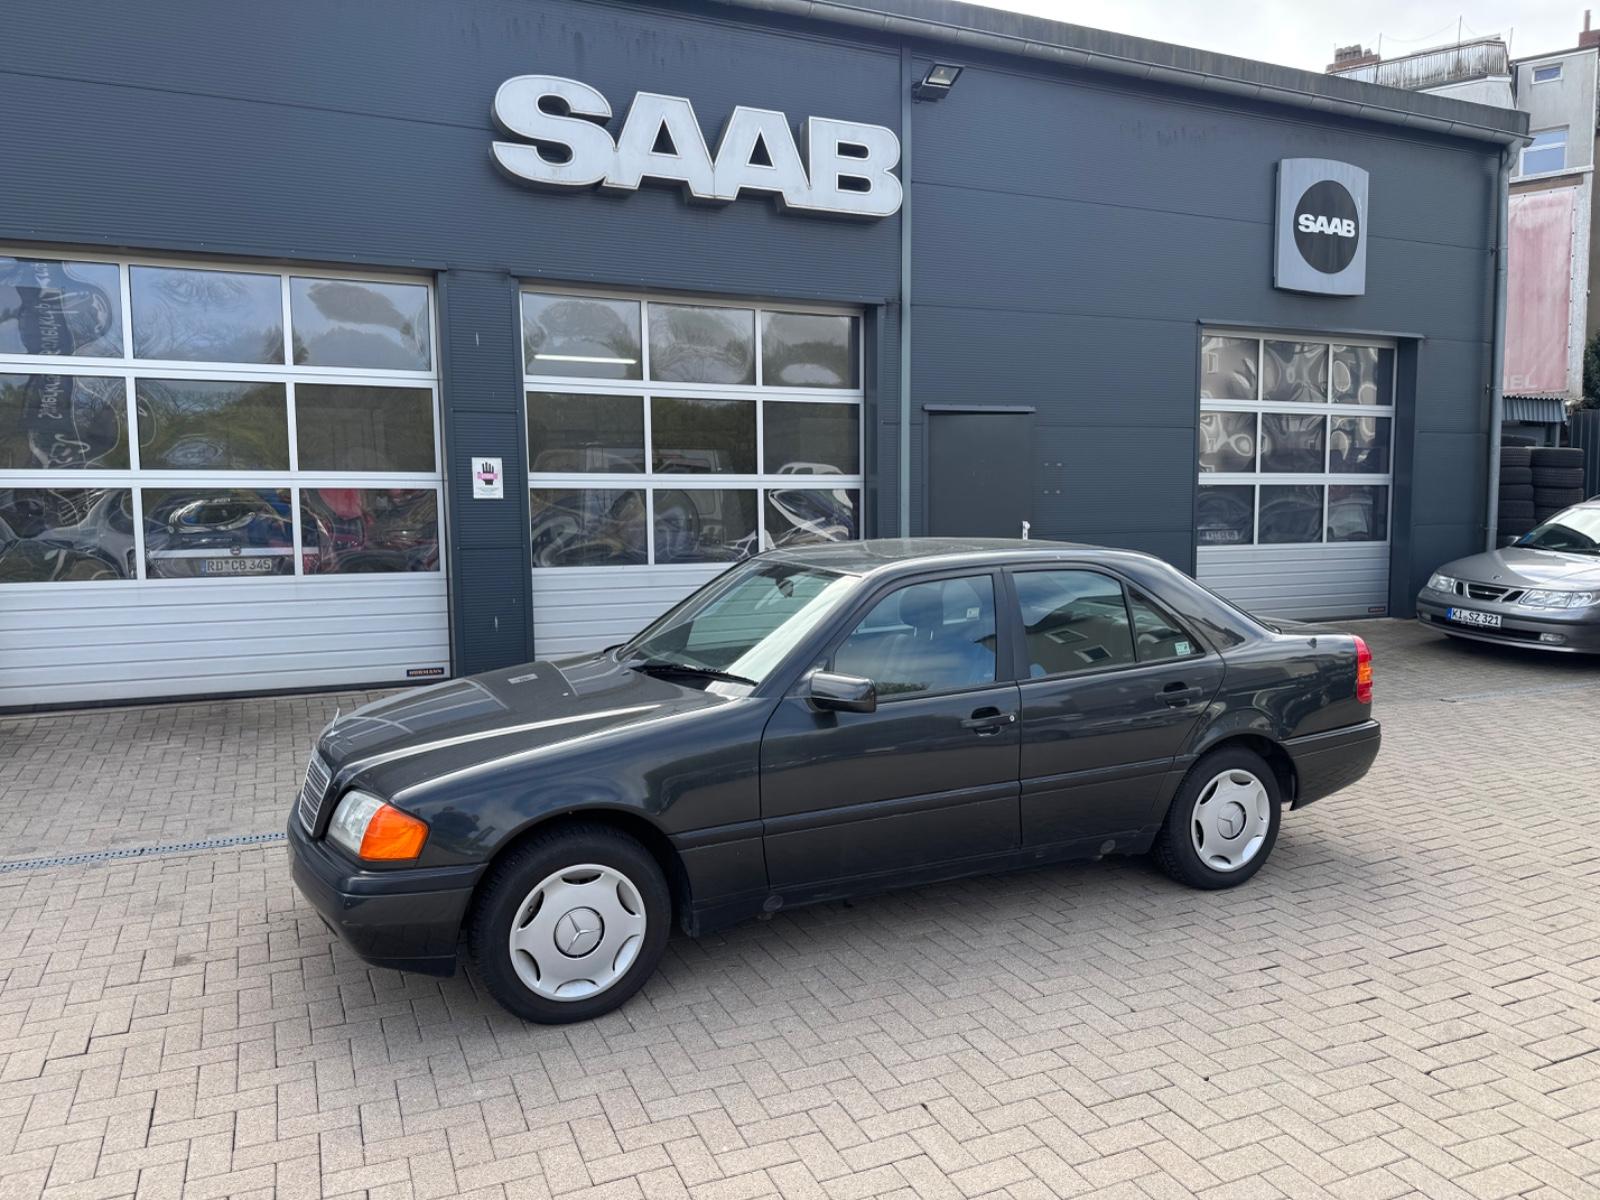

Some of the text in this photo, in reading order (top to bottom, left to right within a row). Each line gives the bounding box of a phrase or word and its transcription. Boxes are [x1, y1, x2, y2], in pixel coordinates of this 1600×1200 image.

[491, 74, 904, 218] SAAB
[1298, 214, 1355, 238] SAAB
[207, 559, 271, 572] RD CB 345
[1452, 607, 1499, 626] KI SZ 321
